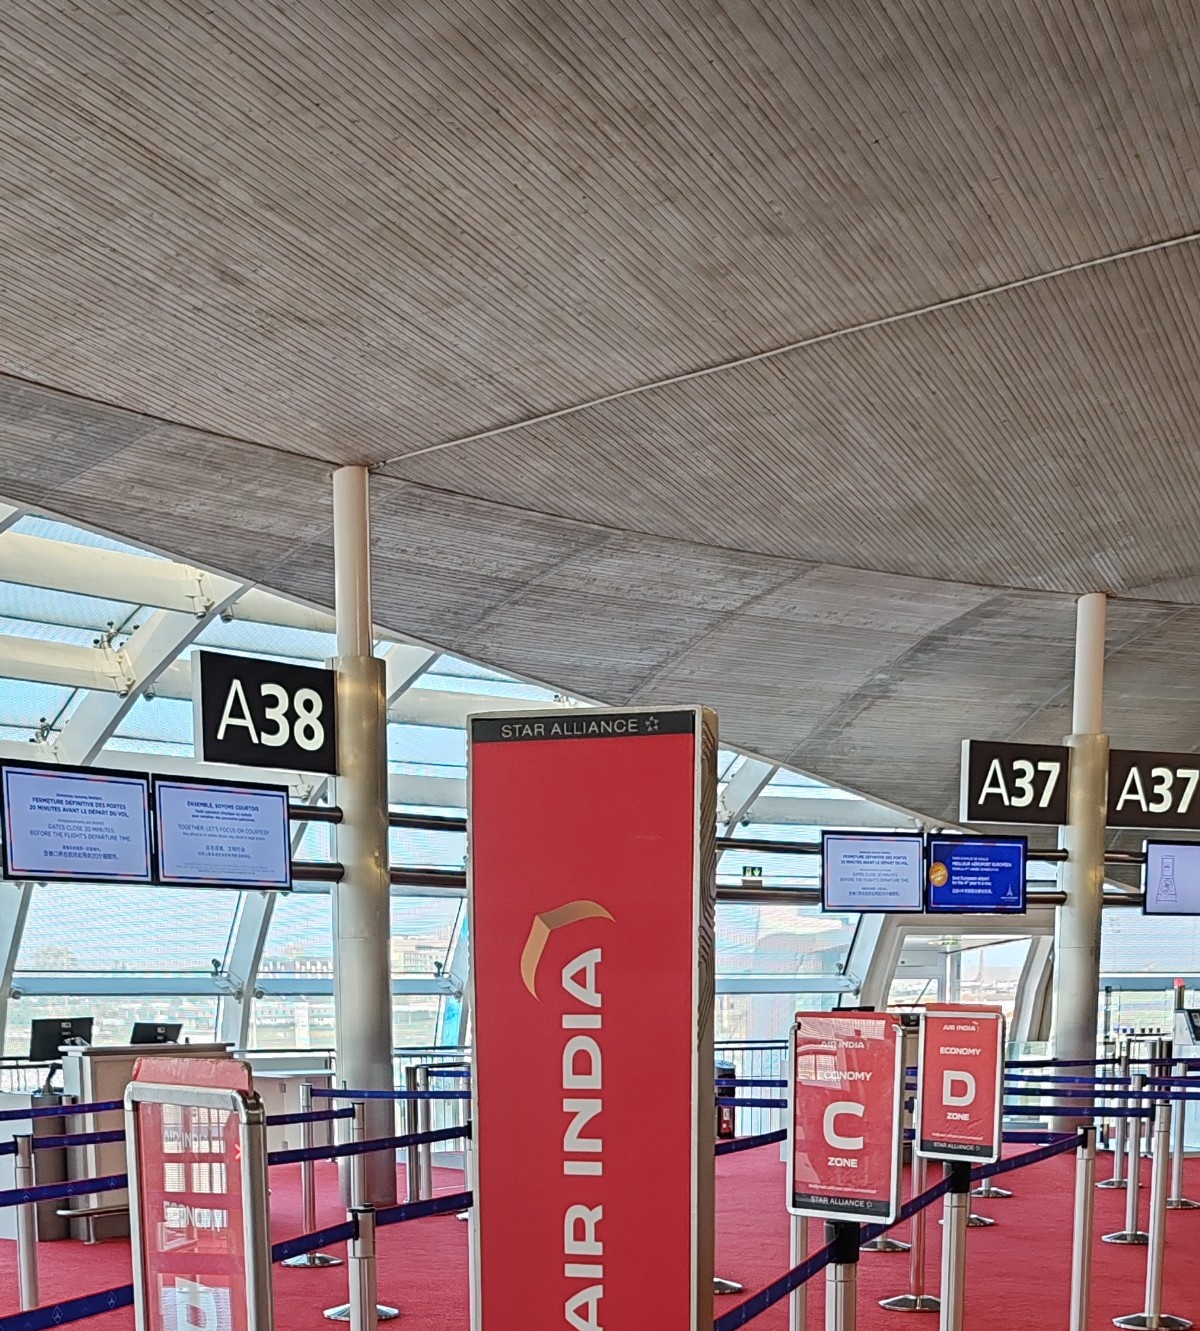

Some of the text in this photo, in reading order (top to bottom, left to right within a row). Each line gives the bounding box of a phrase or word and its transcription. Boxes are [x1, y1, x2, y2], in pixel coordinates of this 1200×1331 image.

[217, 679, 325, 751] A38
[501, 718, 639, 738] STAR ALLIANCE
[978, 758, 1061, 808] A37
[1116, 766, 1200, 814] A37
[32, 797, 64, 805] FERMETURE
[30, 829, 51, 837] BEFORE
[839, 1041, 865, 1049] INDIA
[940, 1047, 981, 1056] ECONOMY
[561, 947, 603, 1176] INDIA
[942, 1070, 976, 1107] D
[946, 1112, 970, 1121] ZONE
[823, 1101, 865, 1150] C
[947, 1143, 975, 1151] ALLIANCE
[827, 1156, 858, 1168] ZONE
[811, 1196, 865, 1208] STAR ALLIANCE
